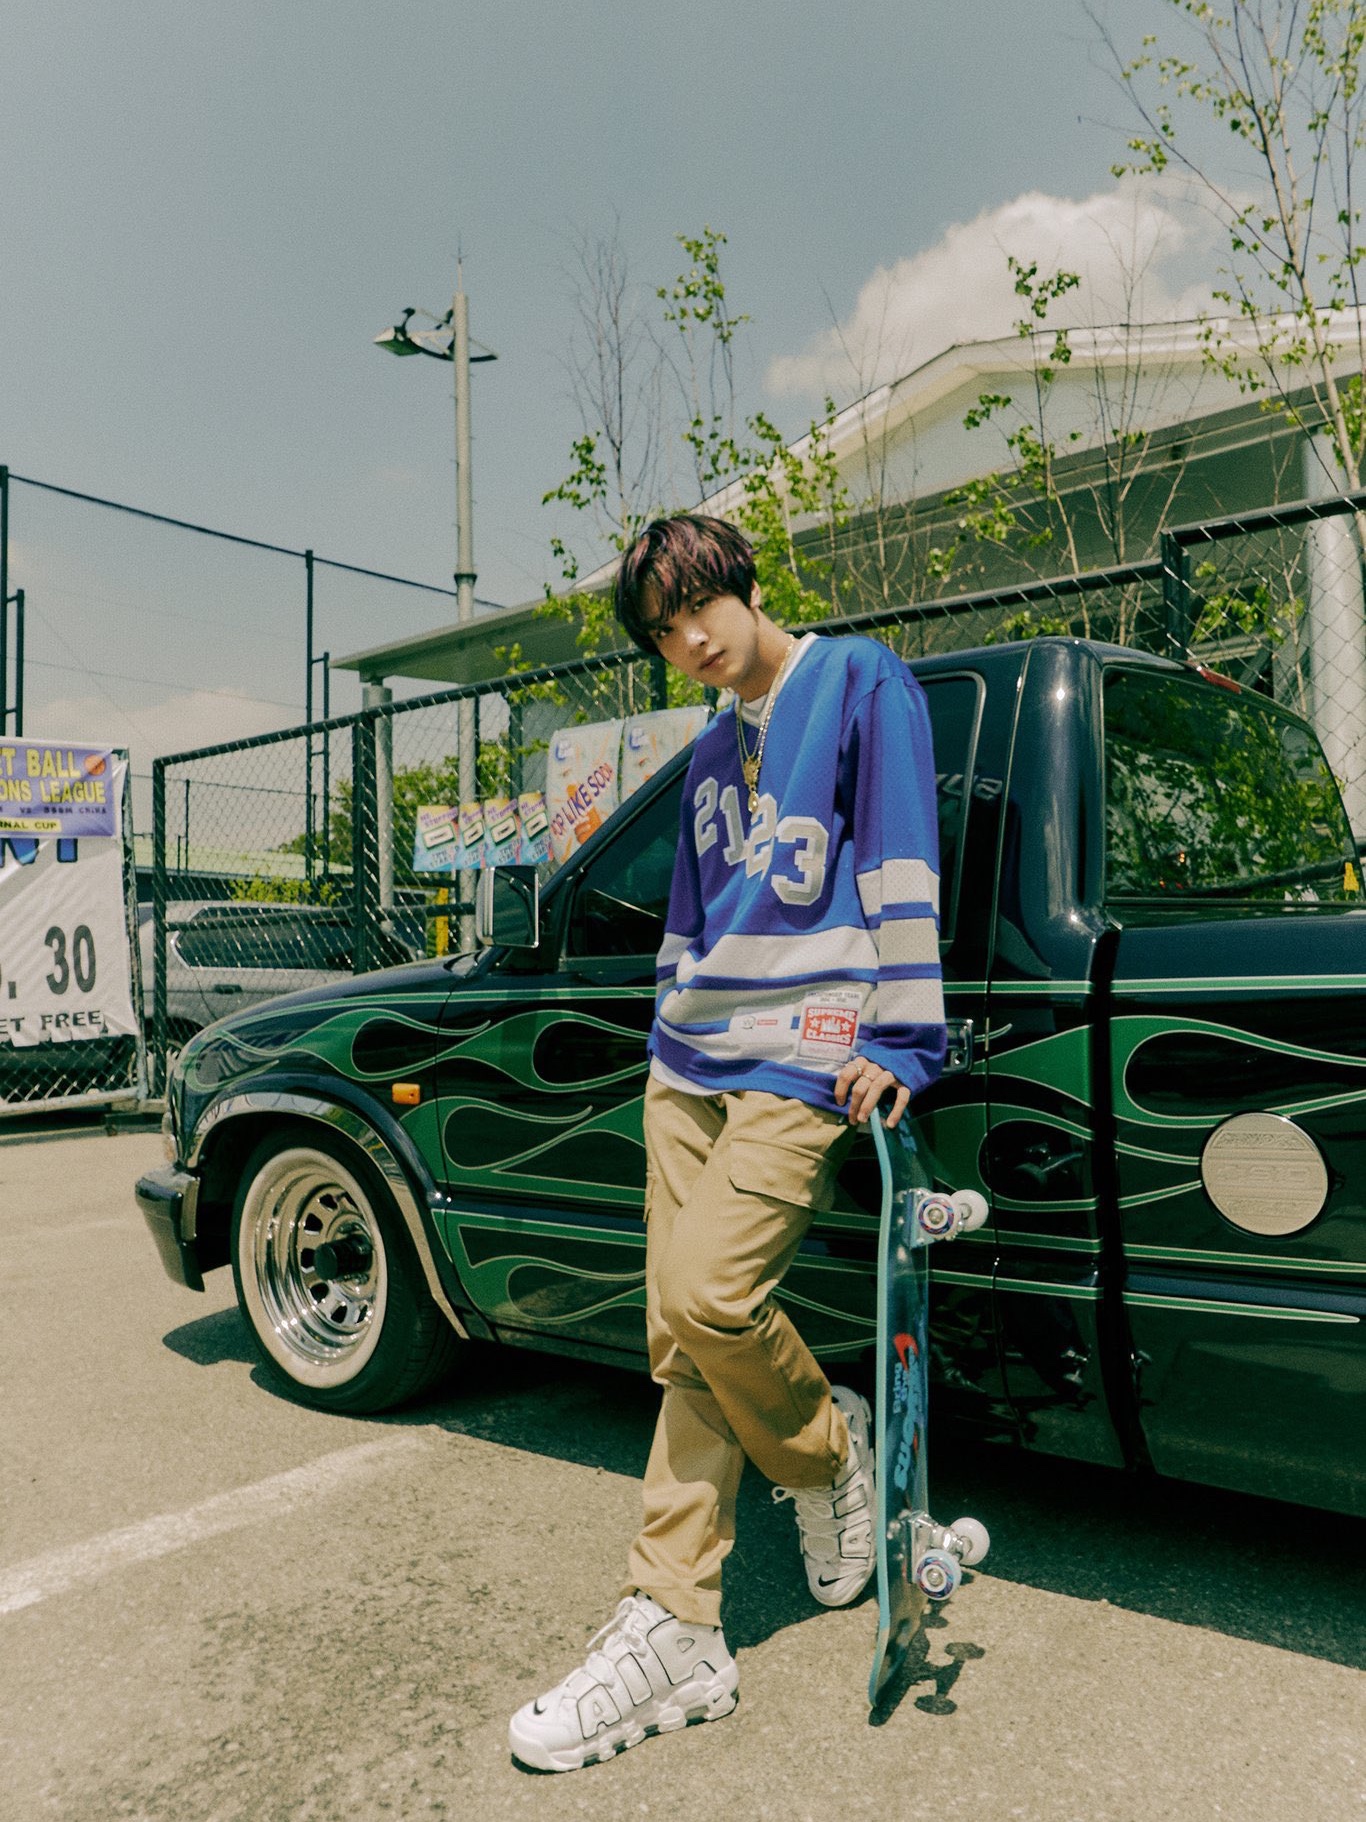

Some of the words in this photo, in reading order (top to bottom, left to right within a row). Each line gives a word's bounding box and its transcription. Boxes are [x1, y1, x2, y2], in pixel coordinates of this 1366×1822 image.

[0, 746, 16, 777] T
[26, 748, 81, 779] BALL
[40, 780, 107, 804] LEAGUE
[562, 783, 593, 825] LIKE
[34, 822, 57, 831] CUP
[44, 924, 96, 995] 30
[40, 1010, 102, 1031] FREE
[577, 1616, 717, 1740] AIR
